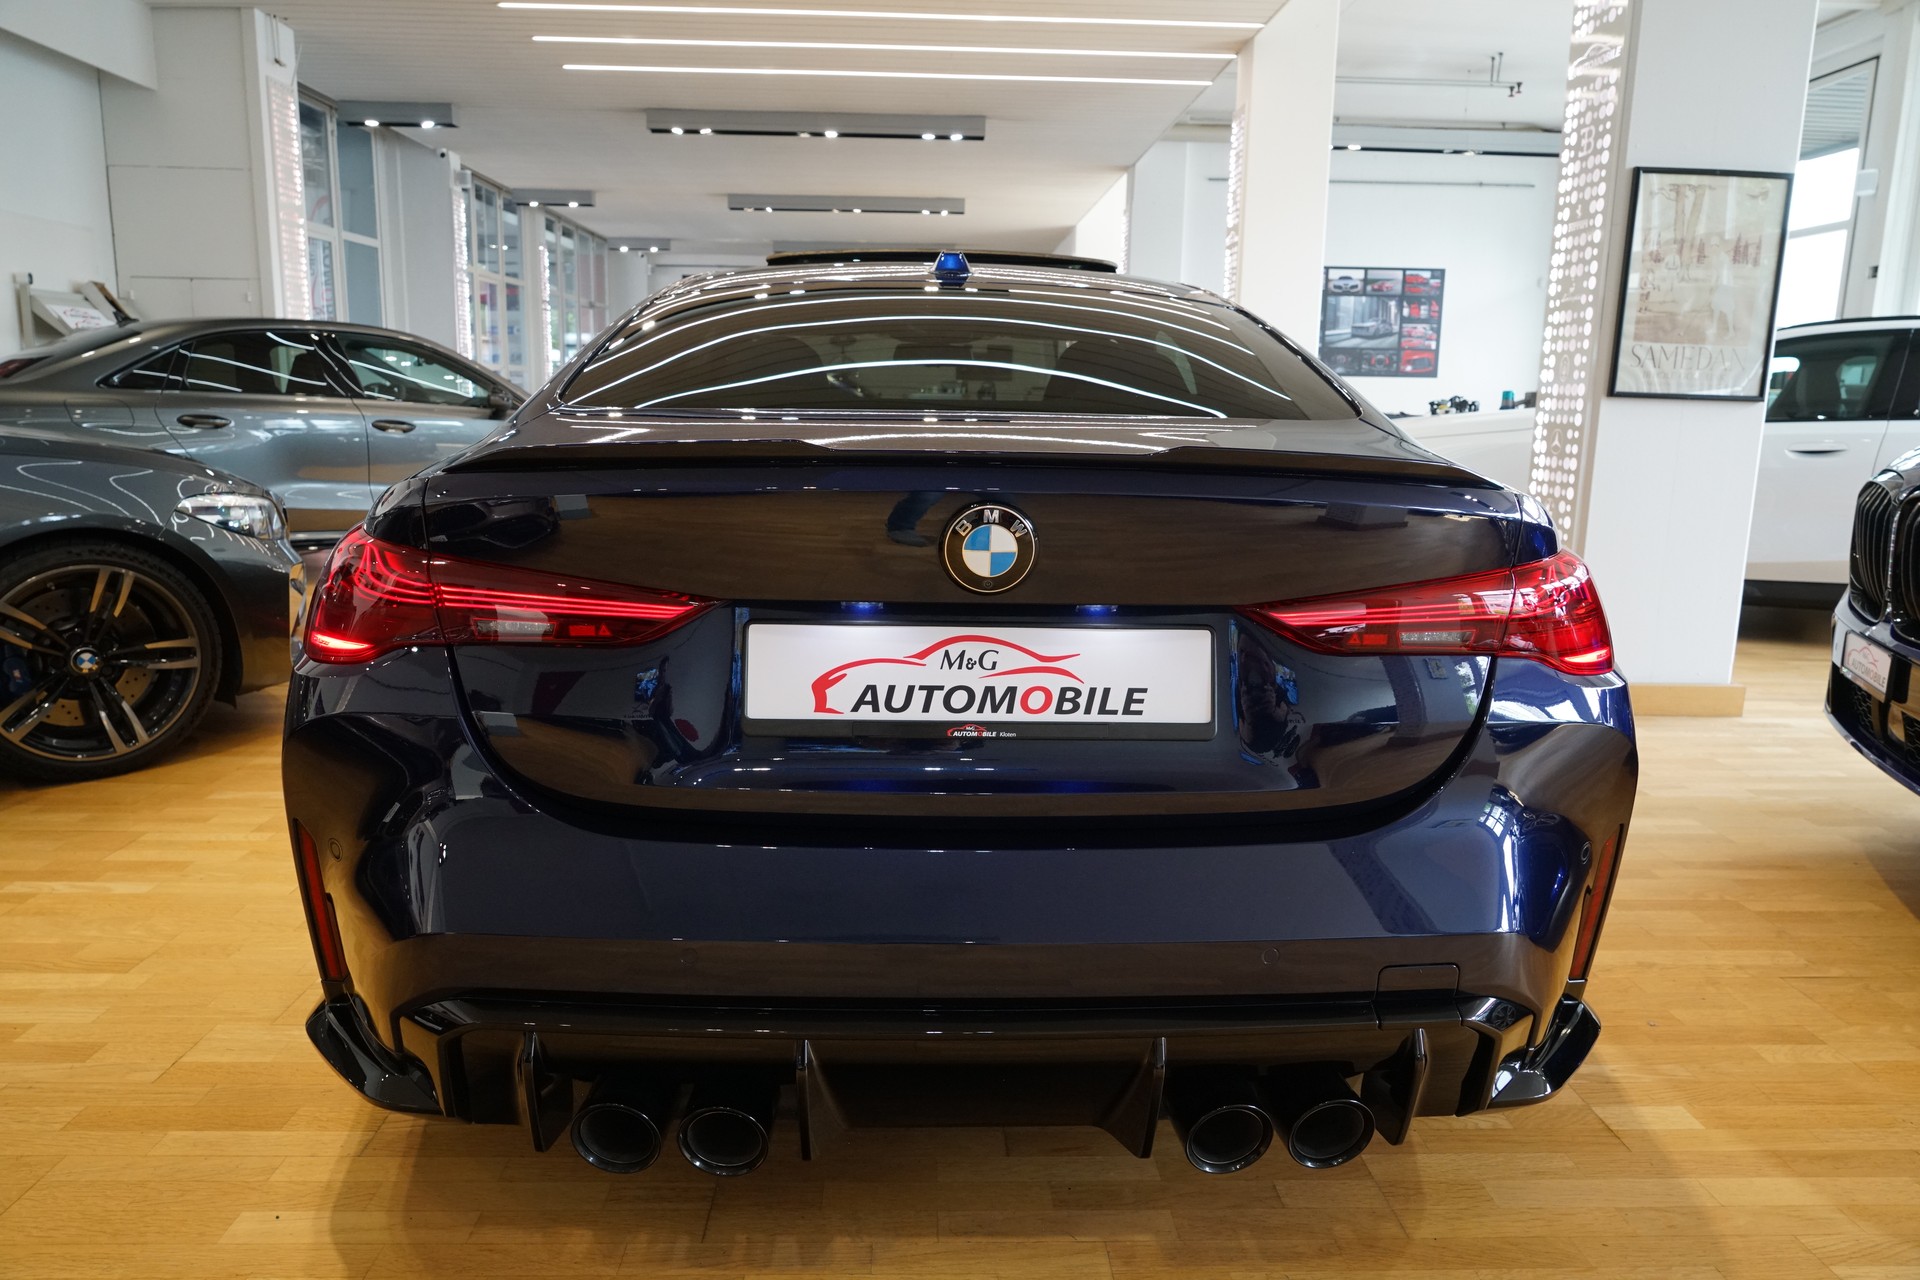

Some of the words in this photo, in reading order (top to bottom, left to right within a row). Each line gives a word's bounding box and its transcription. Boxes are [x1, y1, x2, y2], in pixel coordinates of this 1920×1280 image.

[1630, 343, 1746, 371] SAMEDAN
[955, 509, 1028, 538] BMW
[940, 649, 999, 671] M&G
[850, 684, 1148, 716] AUTOMOBILE
